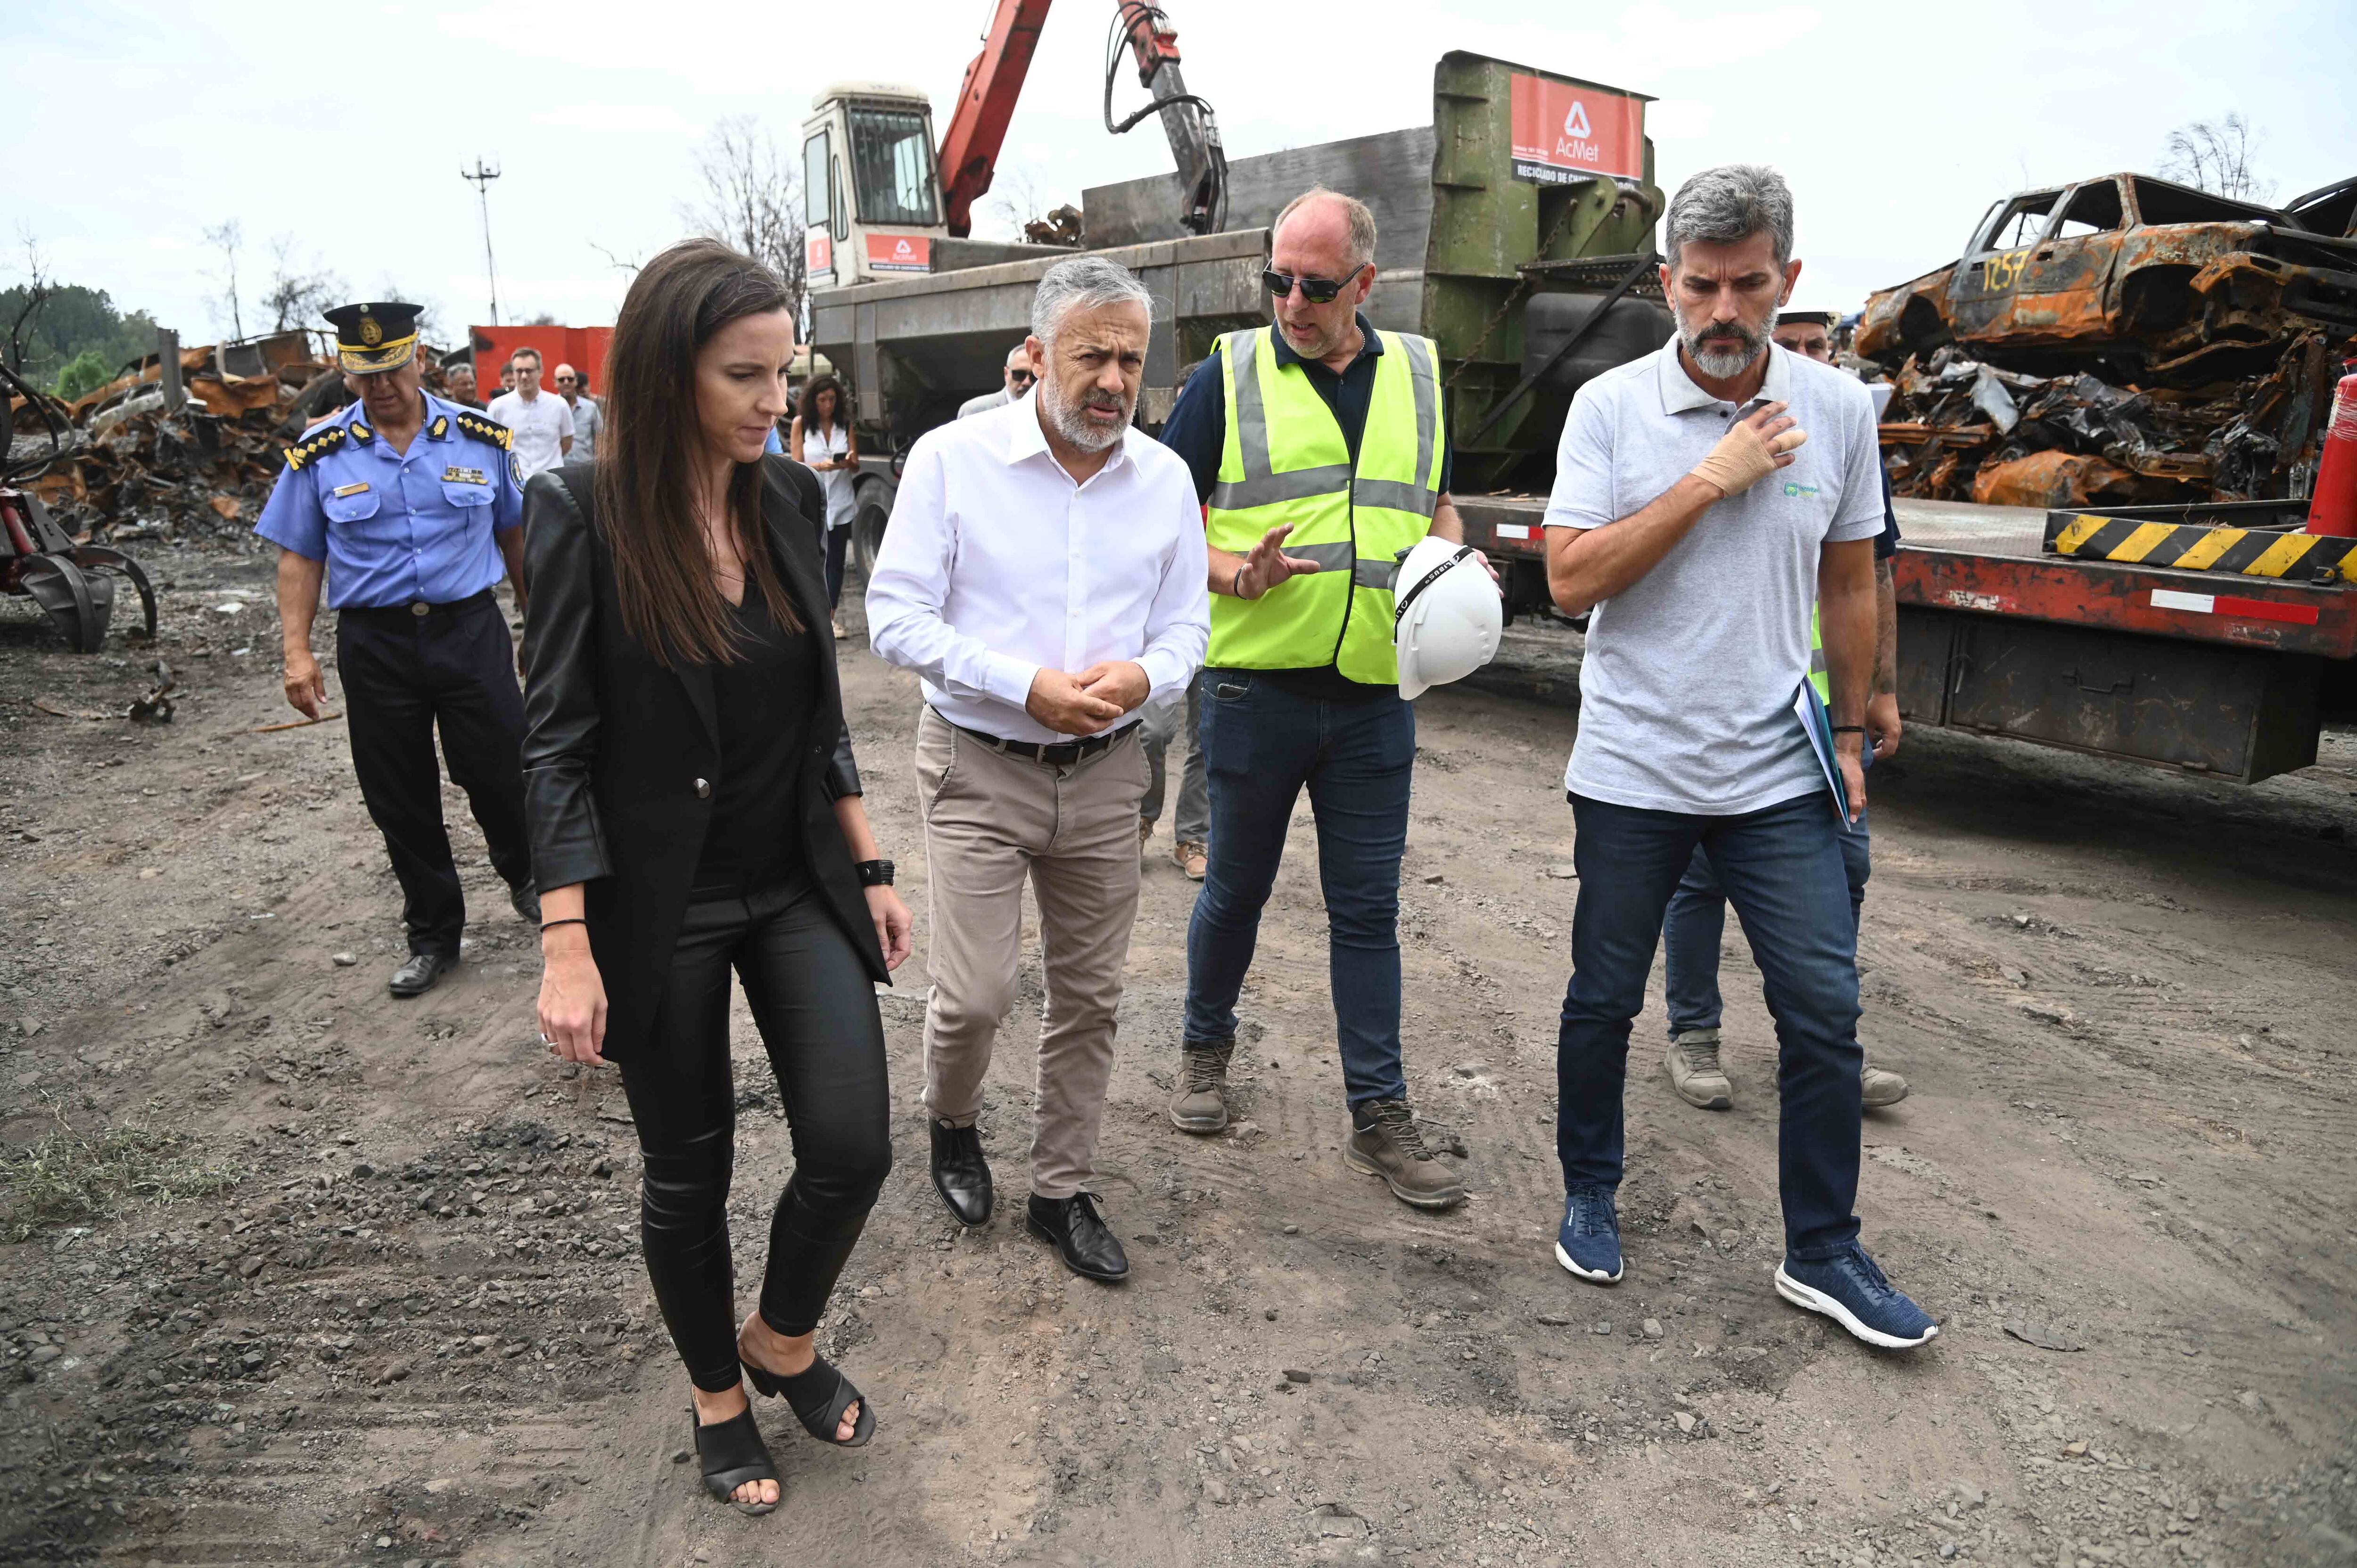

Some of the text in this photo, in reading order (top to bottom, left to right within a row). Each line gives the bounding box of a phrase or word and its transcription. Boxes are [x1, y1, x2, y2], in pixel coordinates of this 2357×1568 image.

[1556, 137, 1599, 162] AcMet
[1517, 164, 1556, 182] RECICLADO
[1557, 172, 1568, 183] DE
